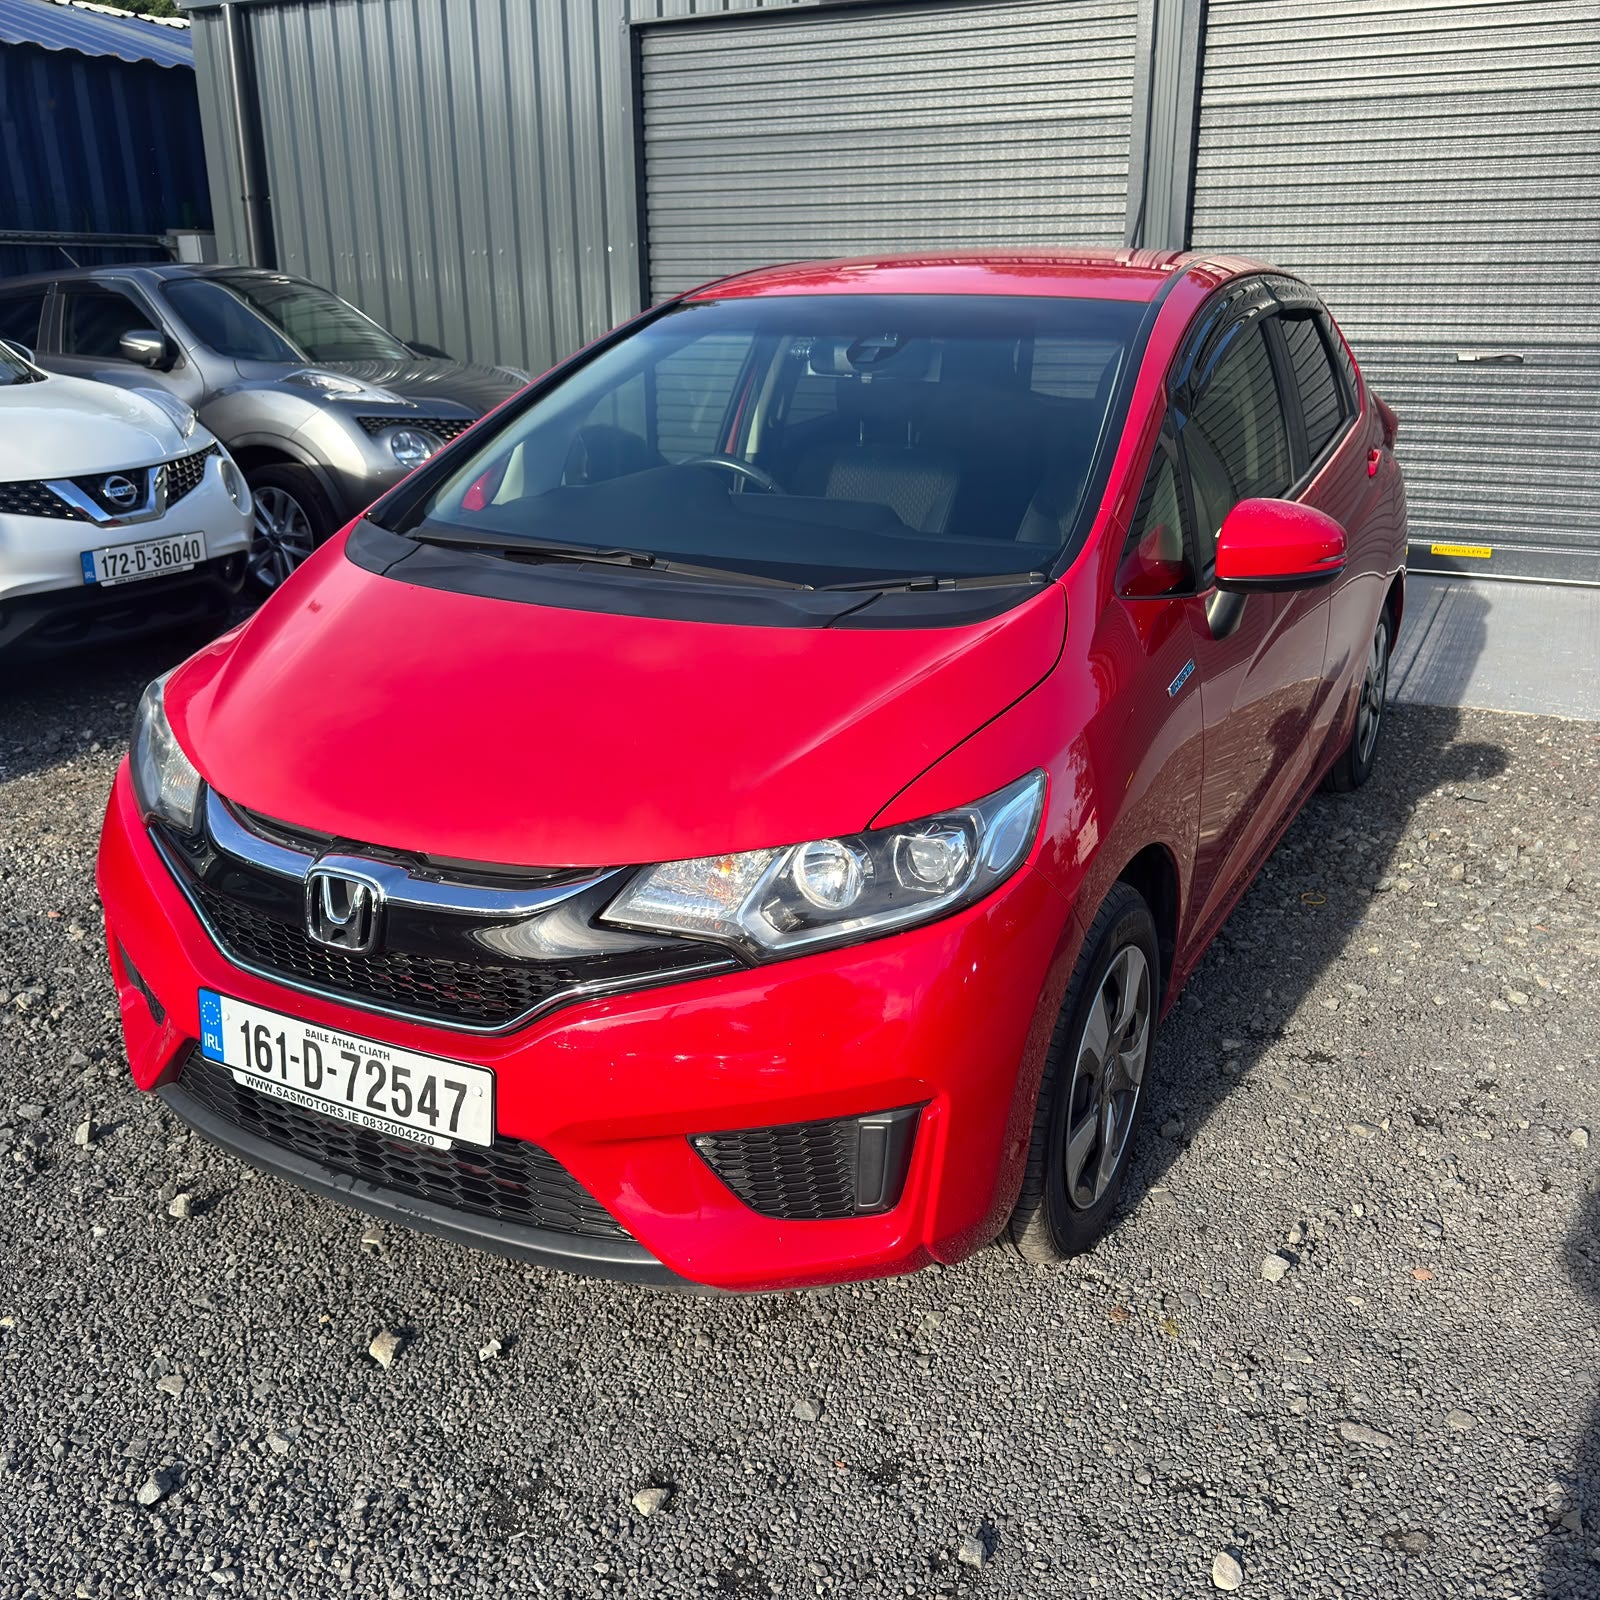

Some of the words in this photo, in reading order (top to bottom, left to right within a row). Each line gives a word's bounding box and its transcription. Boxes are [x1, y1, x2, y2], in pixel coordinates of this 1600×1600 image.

[101, 539, 201, 578] 172-D-36040
[204, 1031, 223, 1052] IRL
[305, 1028, 330, 1043] BAILE
[331, 1034, 356, 1052] ÁTHA
[358, 1044, 391, 1061] CLIATH
[240, 1019, 468, 1133] 161-D-72547
[245, 1074, 360, 1123] WWW.SASMOTORS.IE
[362, 1115, 435, 1146] 0832004220
